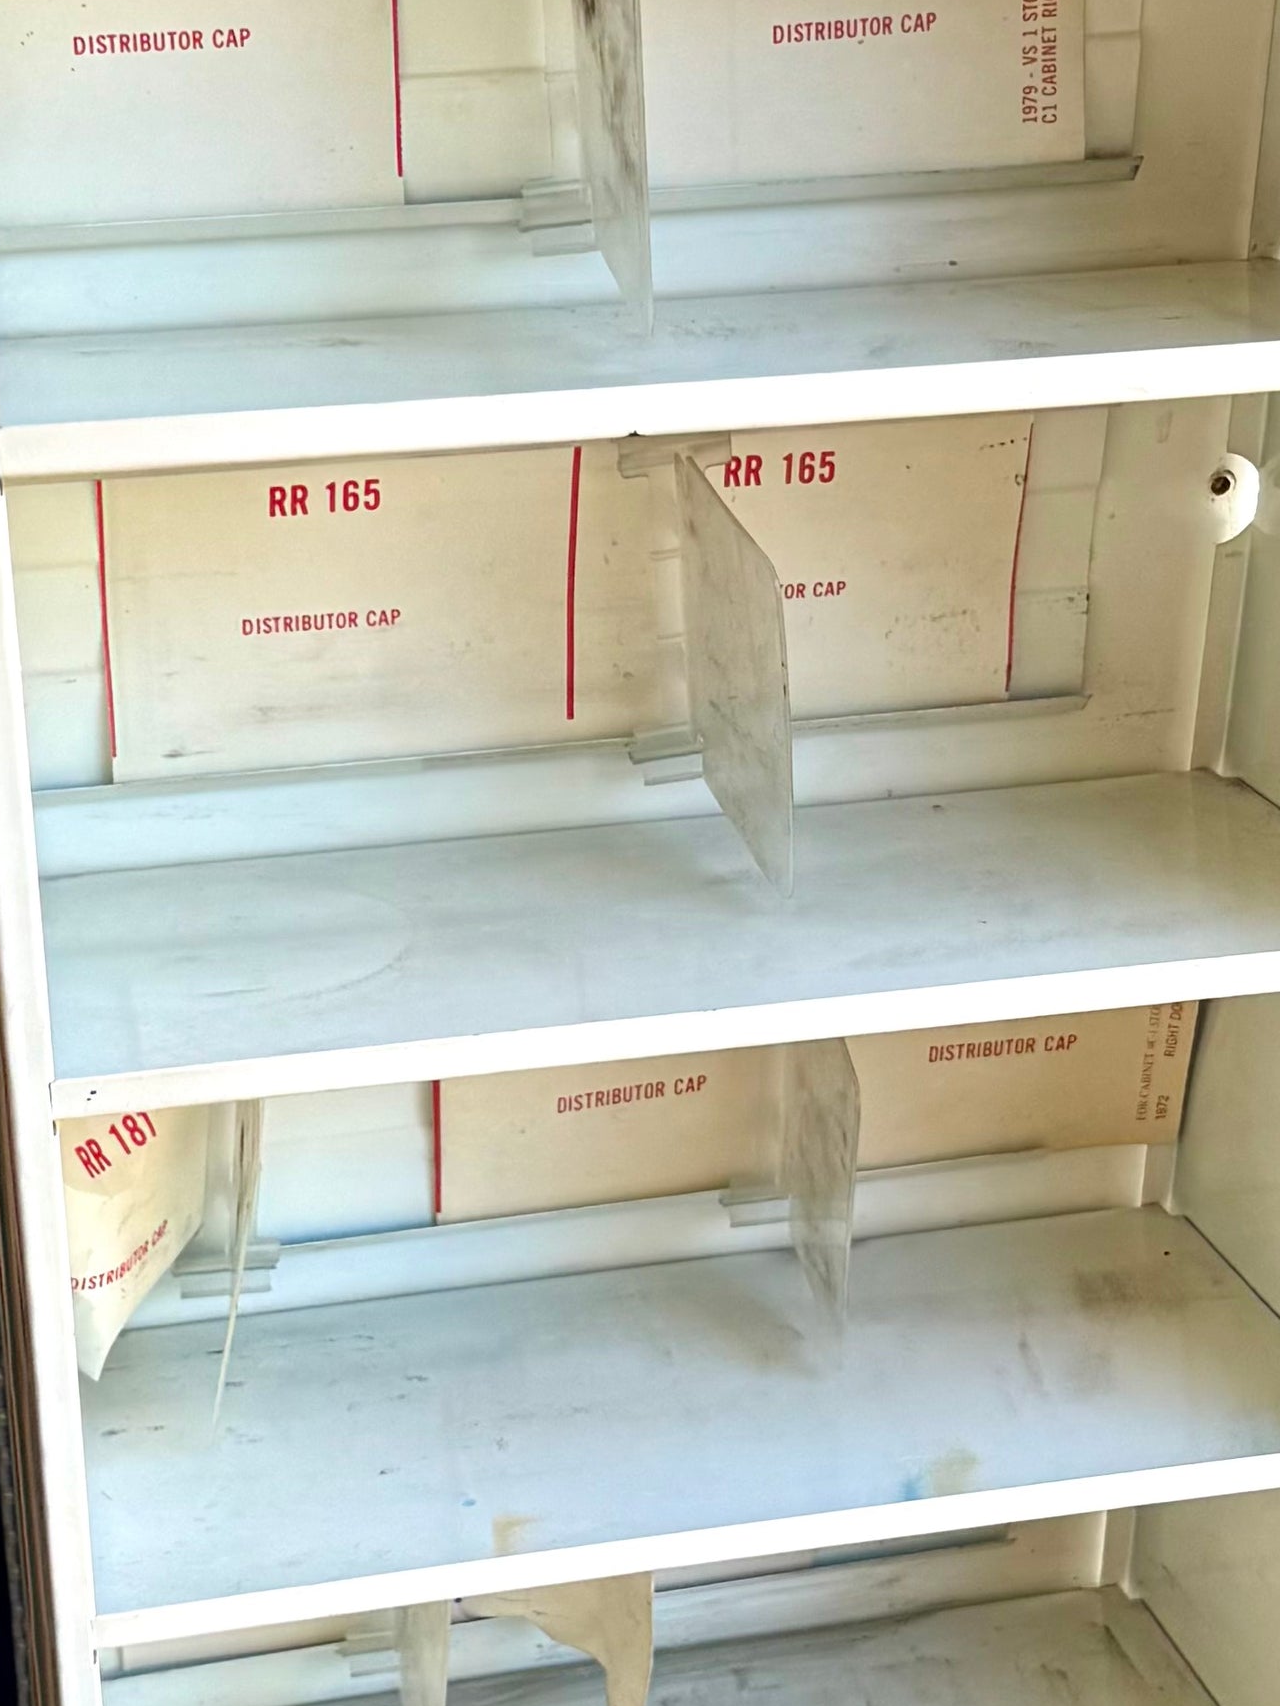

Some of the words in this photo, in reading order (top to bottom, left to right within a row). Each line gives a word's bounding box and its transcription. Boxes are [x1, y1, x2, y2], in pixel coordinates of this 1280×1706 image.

[73, 30, 204, 56] DISTRIBUTOR
[212, 27, 252, 49] CAP
[772, 17, 893, 45] DISTRIBUTOR
[900, 12, 938, 34] CAP
[1022, 45, 1038, 66] VS
[1041, 26, 1057, 96] CABINET
[1022, 85, 1039, 124] 1979
[1041, 104, 1058, 124] C1
[723, 455, 763, 488] RR
[783, 450, 837, 485] 165
[268, 484, 310, 518] RR
[325, 478, 382, 513] 165
[812, 580, 847, 598] CAP
[241, 612, 359, 636] DISTRIBUTOR
[366, 609, 402, 629] CAP
[1149, 1005, 1162, 1029] STO
[1169, 1002, 1184, 1021] DO
[928, 1037, 1037, 1065] DISTRIBUTOR
[1044, 1033, 1078, 1053] CAP
[1164, 1024, 1180, 1057] RIGHT
[557, 1081, 666, 1114] DISTRIBUTOR
[673, 1074, 708, 1095] CAP
[74, 1138, 113, 1179] RR
[71, 1240, 149, 1291] DISTRIBUTOR
